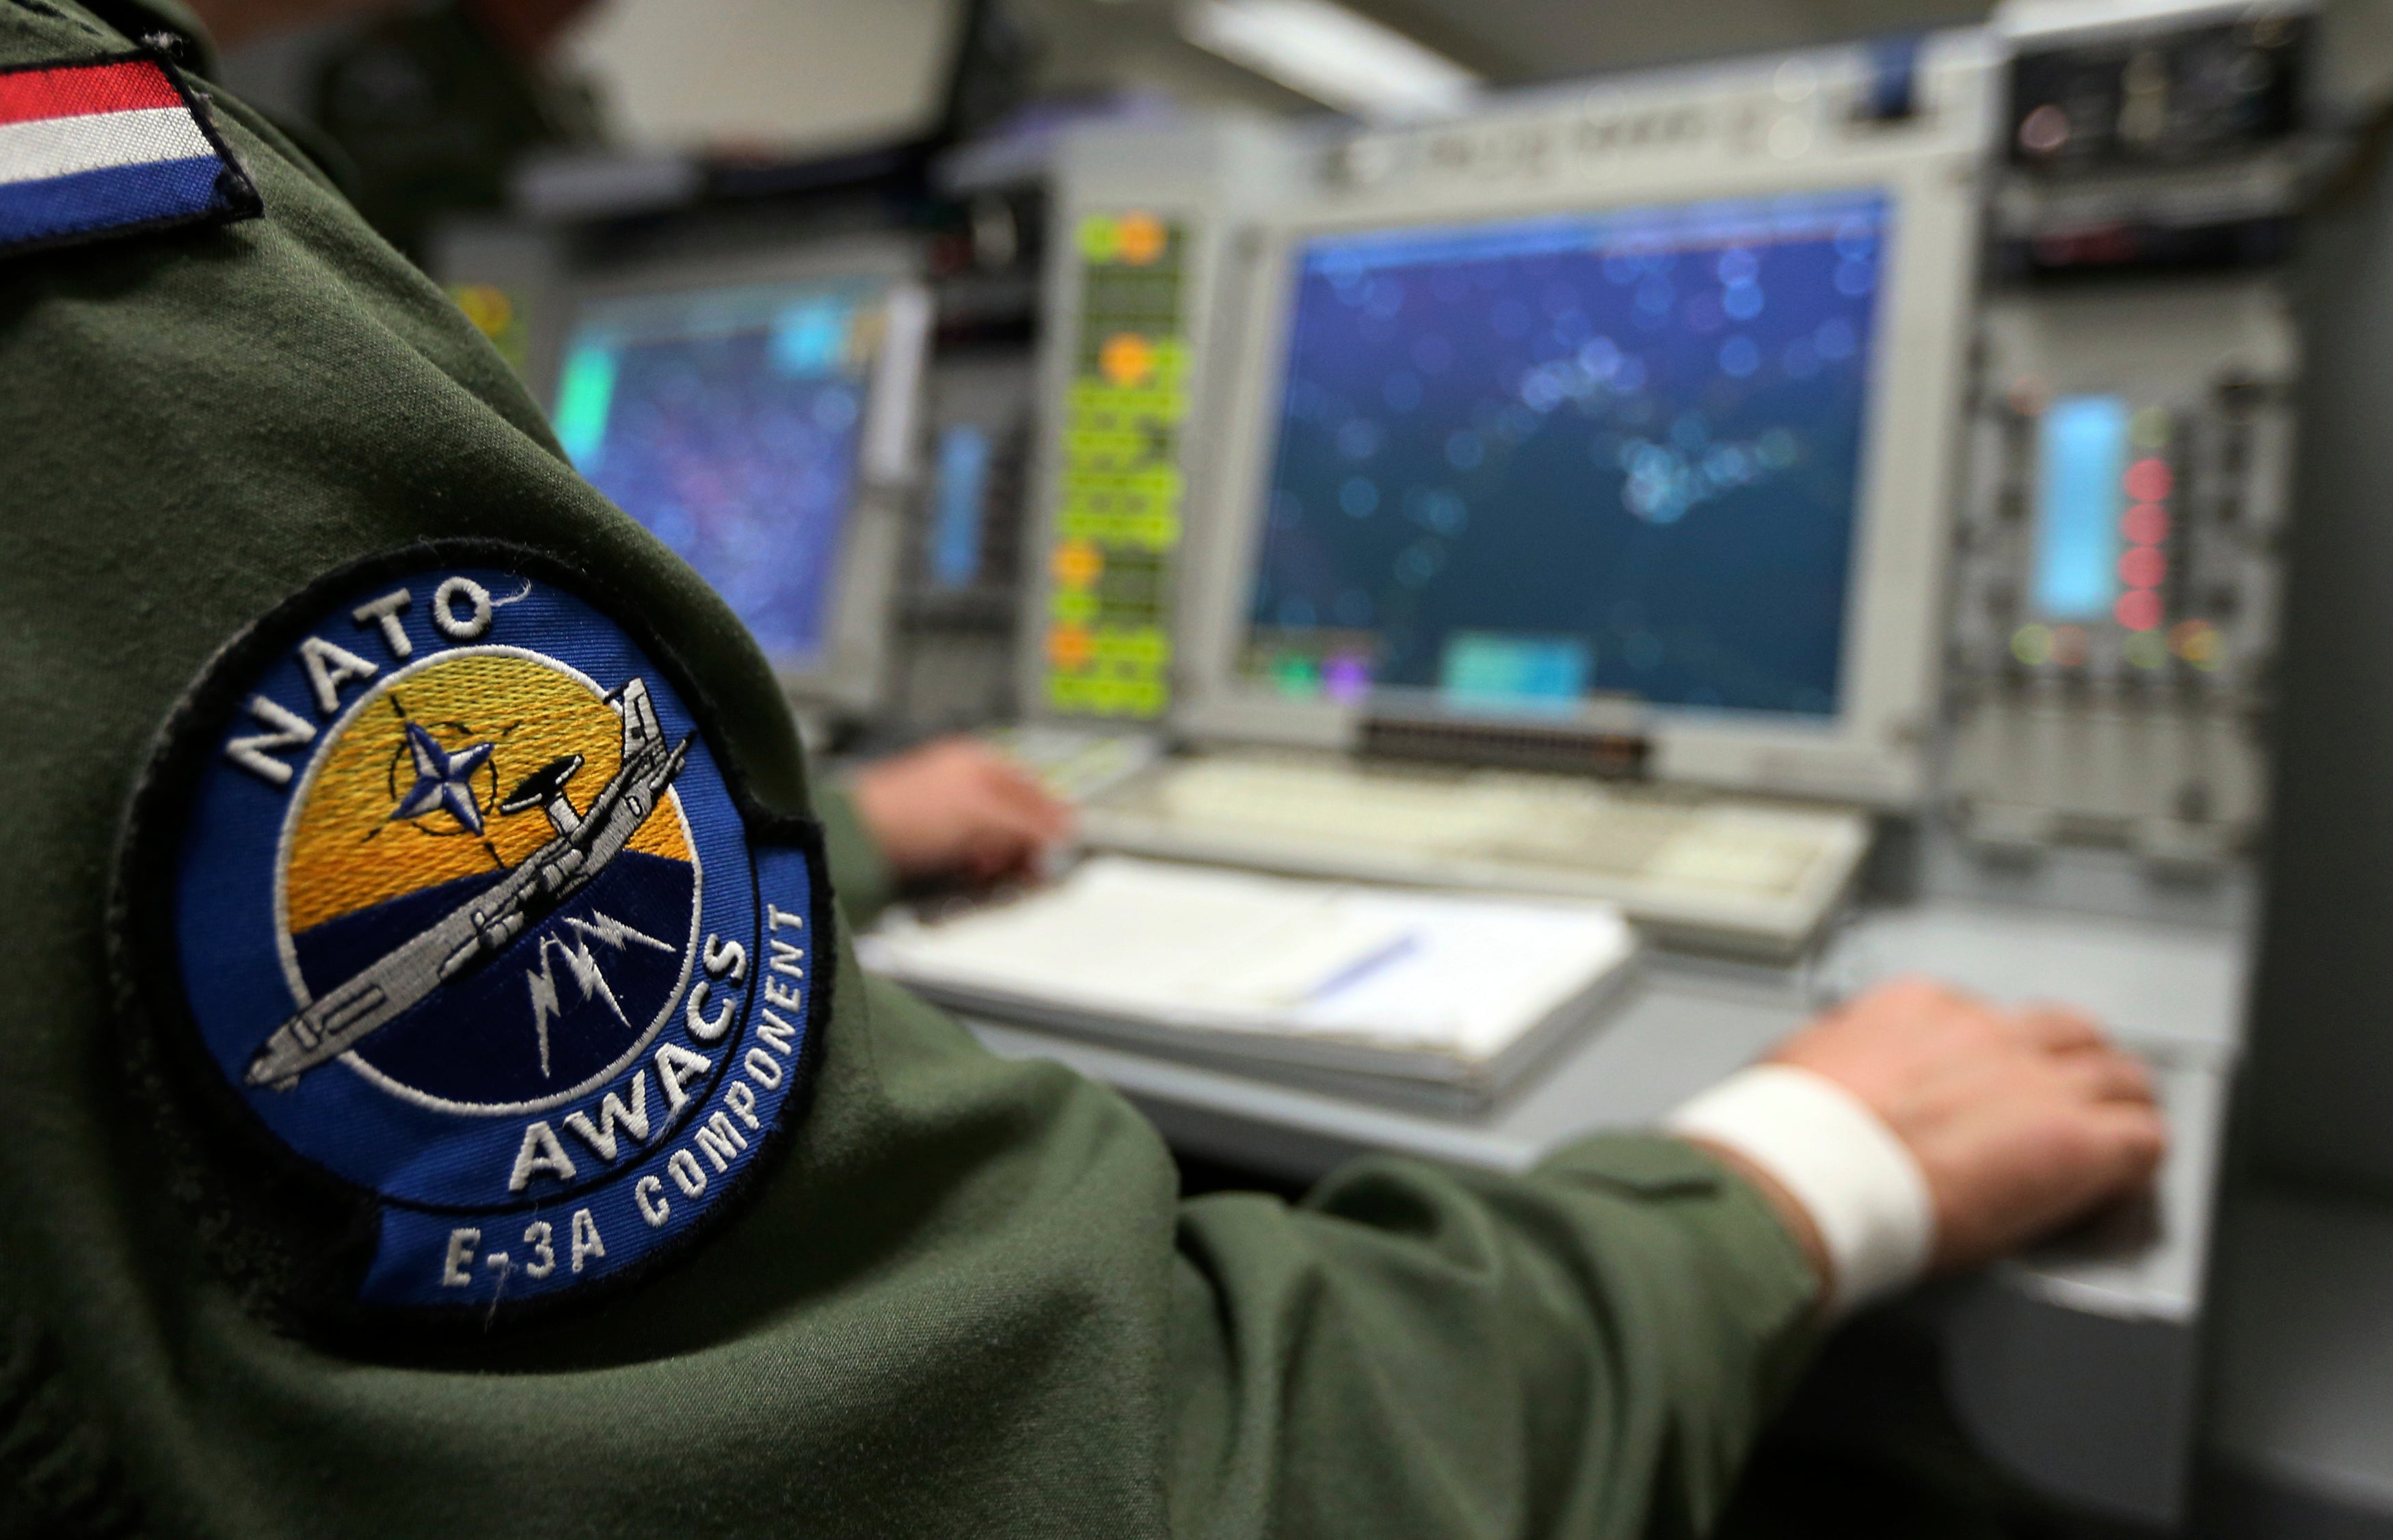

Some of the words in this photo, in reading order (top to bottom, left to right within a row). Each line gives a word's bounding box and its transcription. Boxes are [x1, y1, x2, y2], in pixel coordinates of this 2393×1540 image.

[224, 576, 493, 785] NATO
[442, 1208, 606, 1287] E-3A
[634, 903, 805, 1228] COMPONENT
[508, 933, 747, 1191] AWACS
